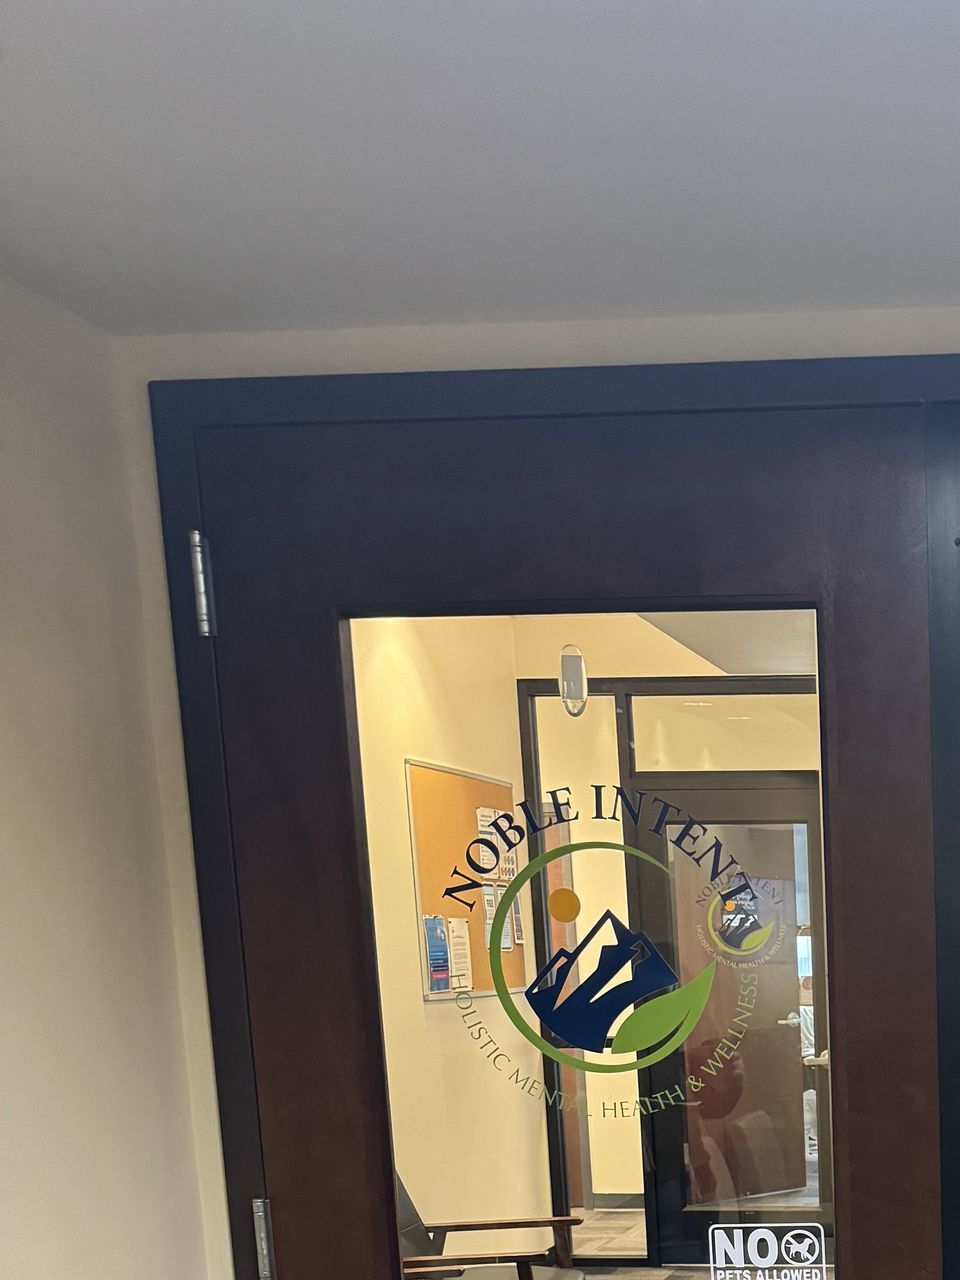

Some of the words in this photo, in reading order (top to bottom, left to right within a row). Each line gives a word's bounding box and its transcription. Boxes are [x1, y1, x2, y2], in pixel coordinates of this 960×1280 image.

[442, 787, 579, 912] NOBLE
[591, 785, 759, 907] INTENT
[450, 973, 511, 1071] HOLISTIC
[602, 1084, 685, 1118] HEALTH
[687, 1075, 706, 1092] &
[700, 971, 759, 1077] WELLNESS
[714, 1228, 778, 1268] NO
